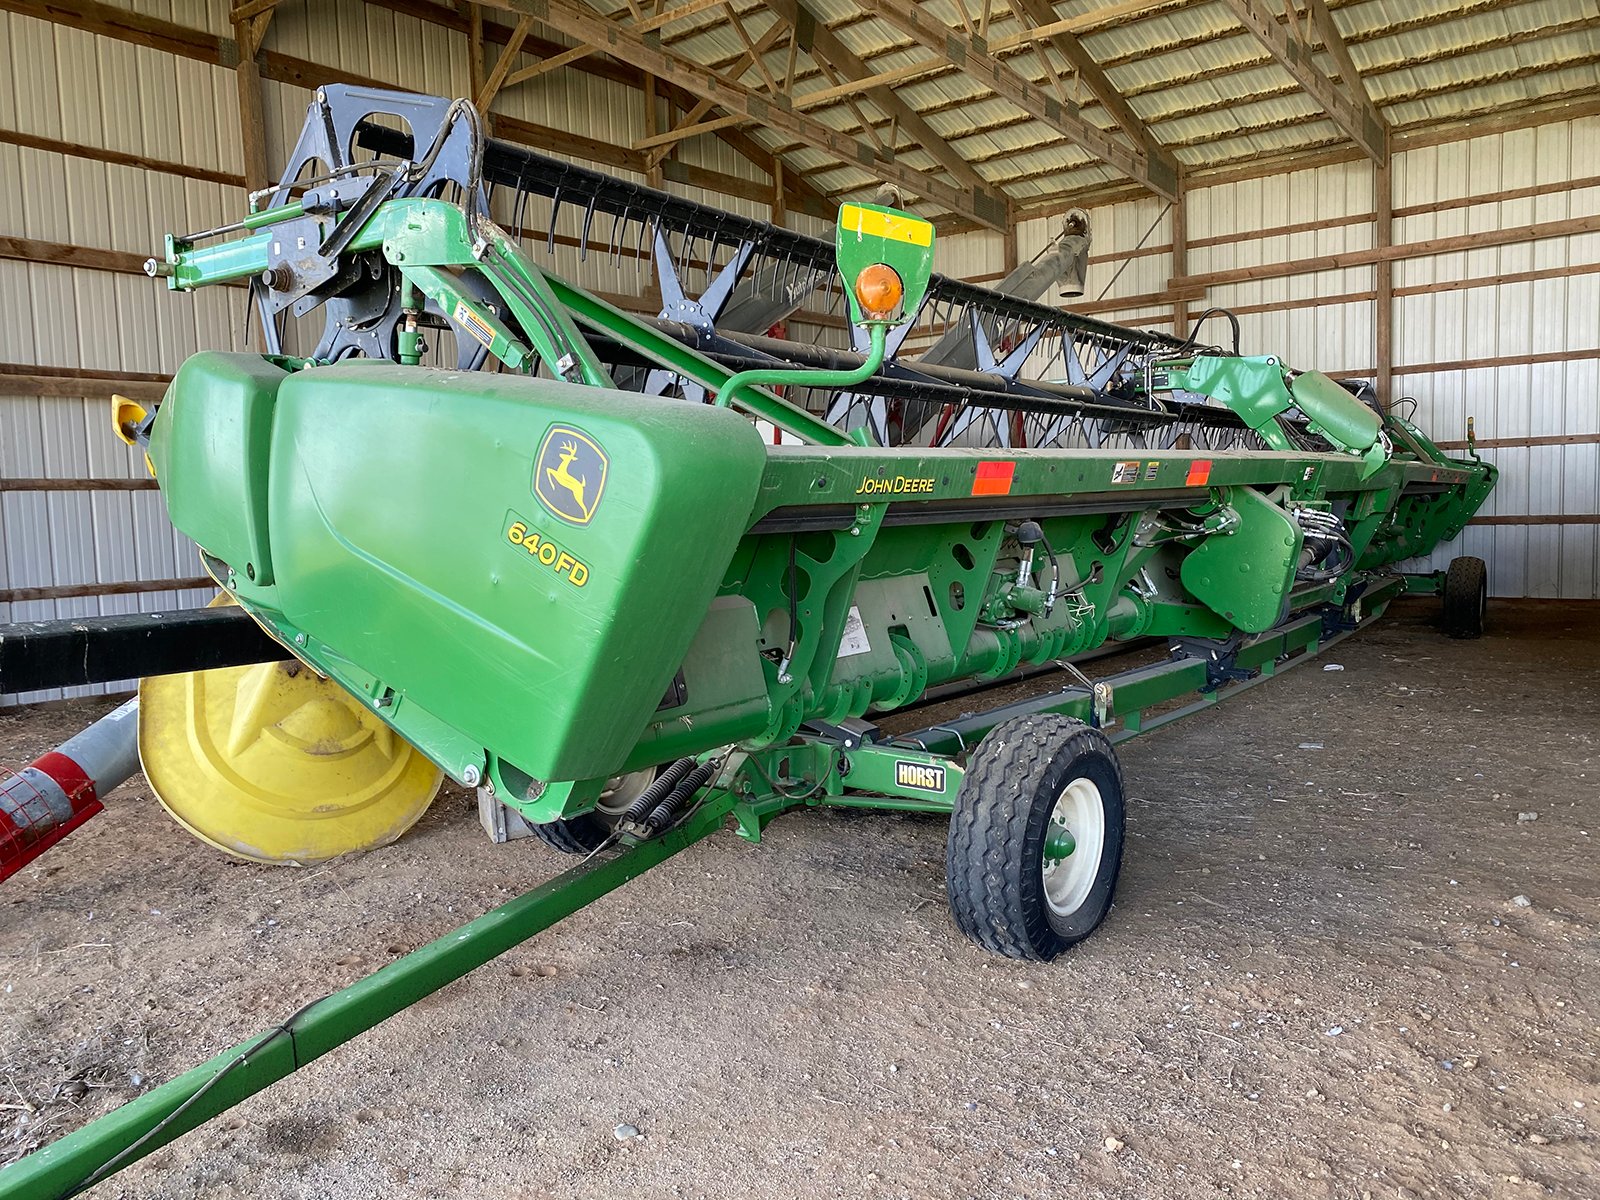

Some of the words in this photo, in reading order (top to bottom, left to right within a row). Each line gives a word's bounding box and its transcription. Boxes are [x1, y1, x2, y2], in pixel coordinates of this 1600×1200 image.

[856, 475, 893, 494] JOHN
[893, 475, 935, 493] DEERE
[507, 521, 590, 588] 640FD
[898, 764, 944, 789] HORST
